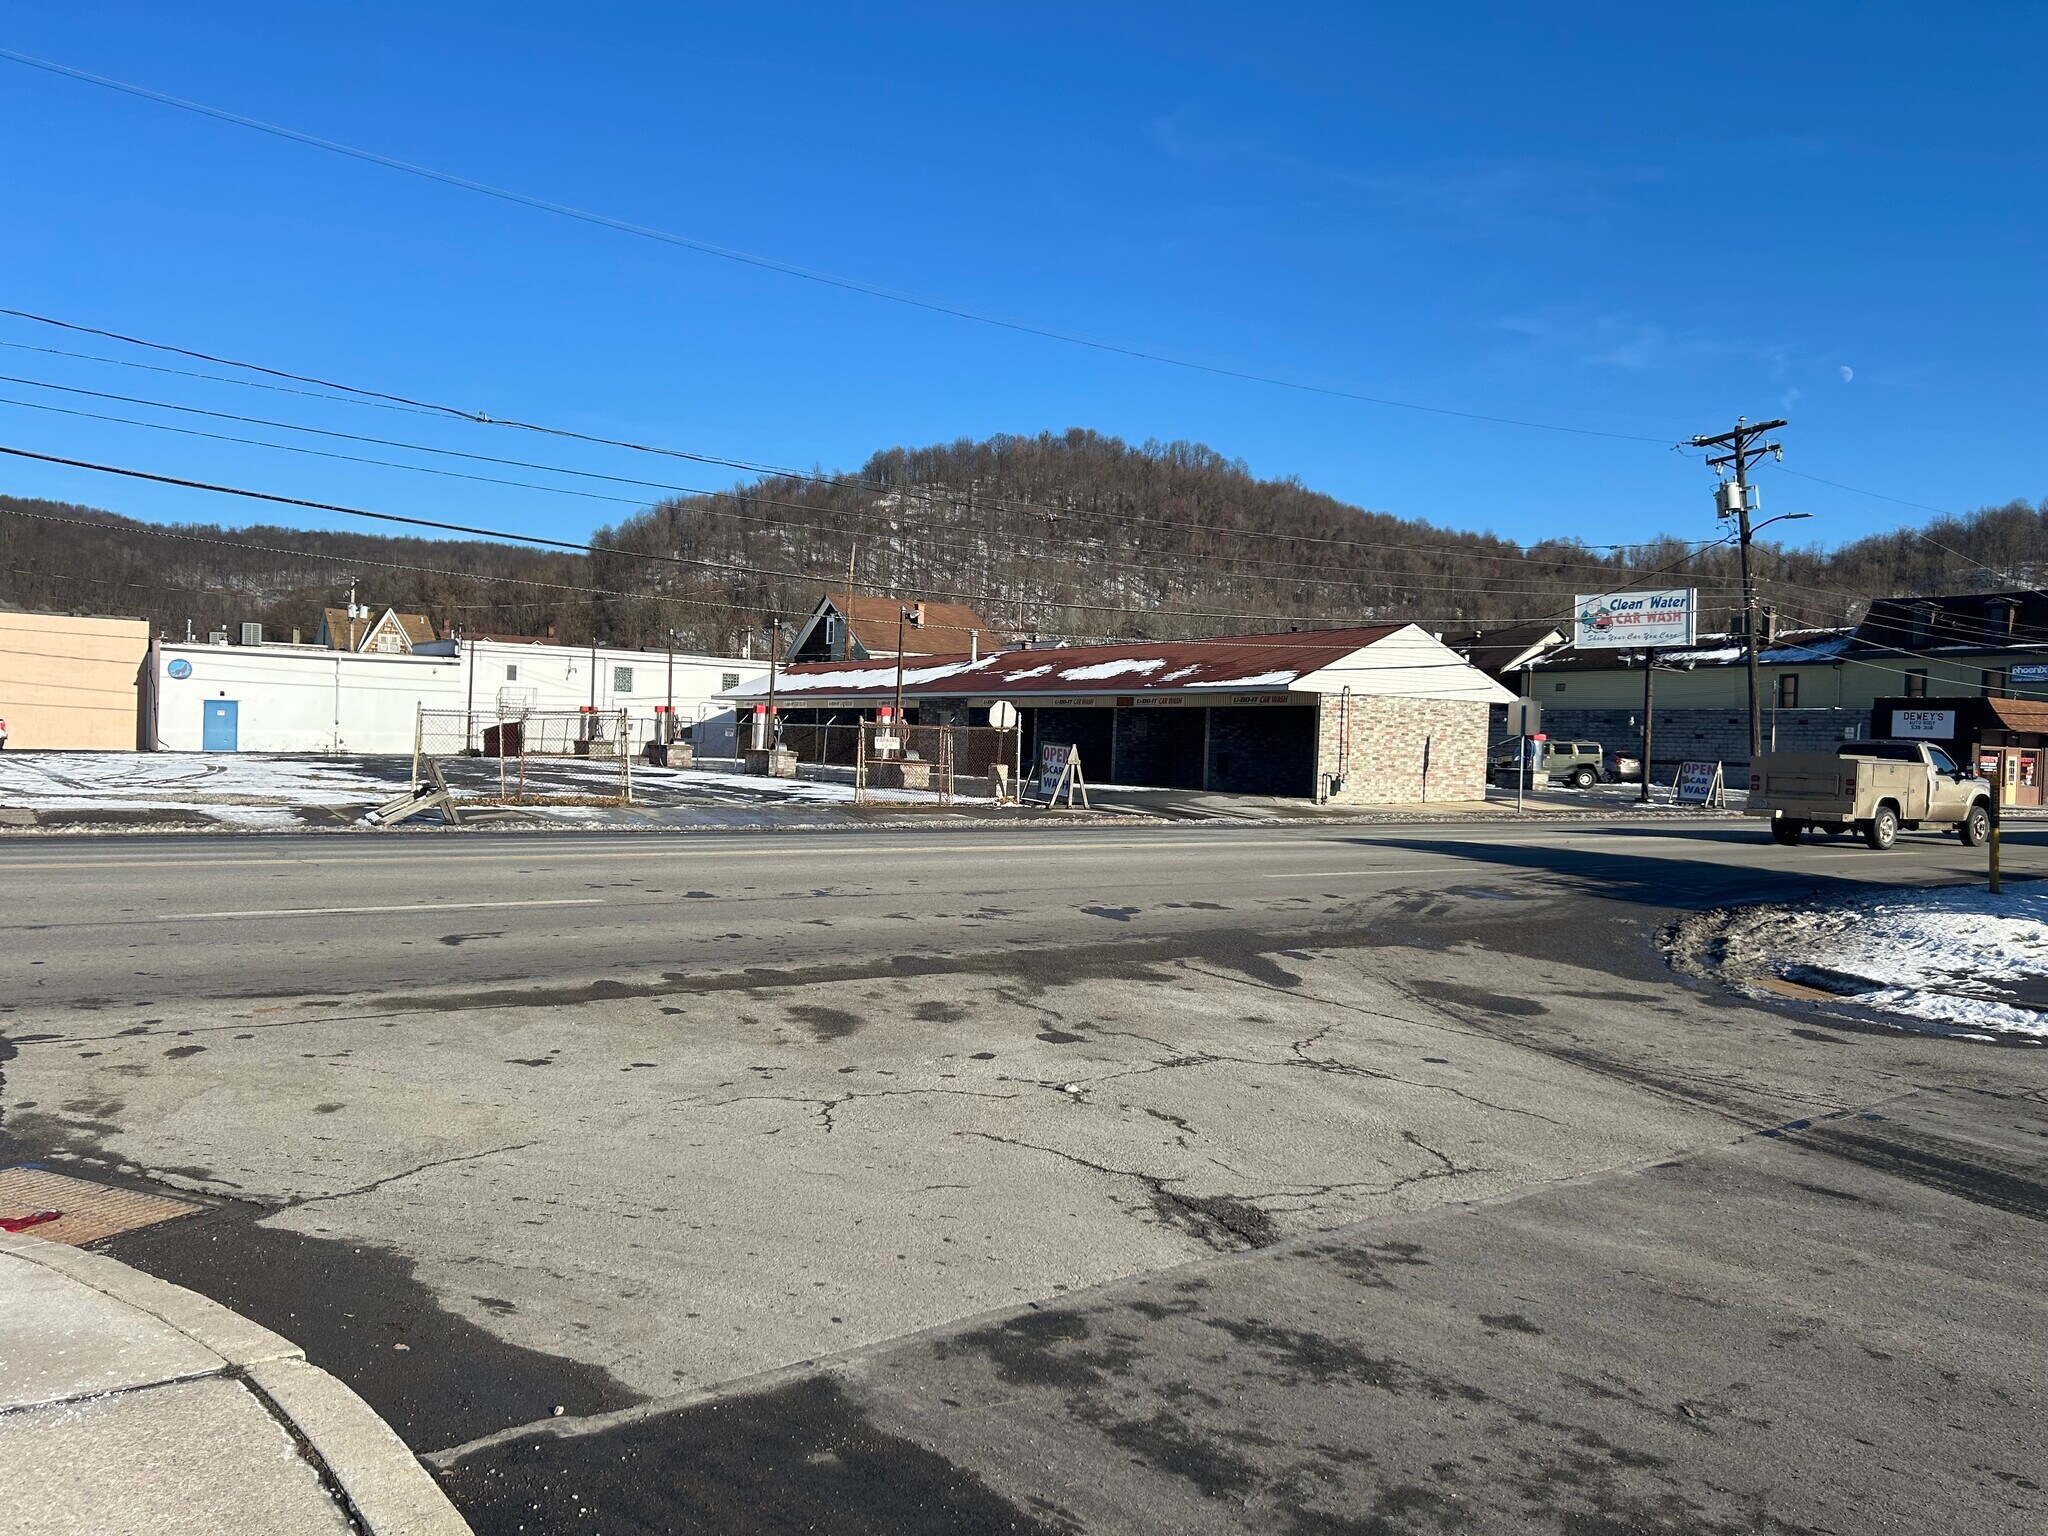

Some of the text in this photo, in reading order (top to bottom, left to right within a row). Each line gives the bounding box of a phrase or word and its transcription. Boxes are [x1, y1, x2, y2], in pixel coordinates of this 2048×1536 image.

[1610, 596, 1686, 611] Clean Water
[1616, 610, 1681, 624] CAR WASH
[1587, 631, 1678, 642] Show Your Car You Care
[1271, 695, 1288, 703] WASH
[1903, 711, 1944, 721] DEWEY'S
[1043, 746, 1070, 763] OPEN
[1683, 762, 1717, 776] OPEN
[1043, 777, 1069, 790] WAH
[1690, 776, 1708, 785] CAR
